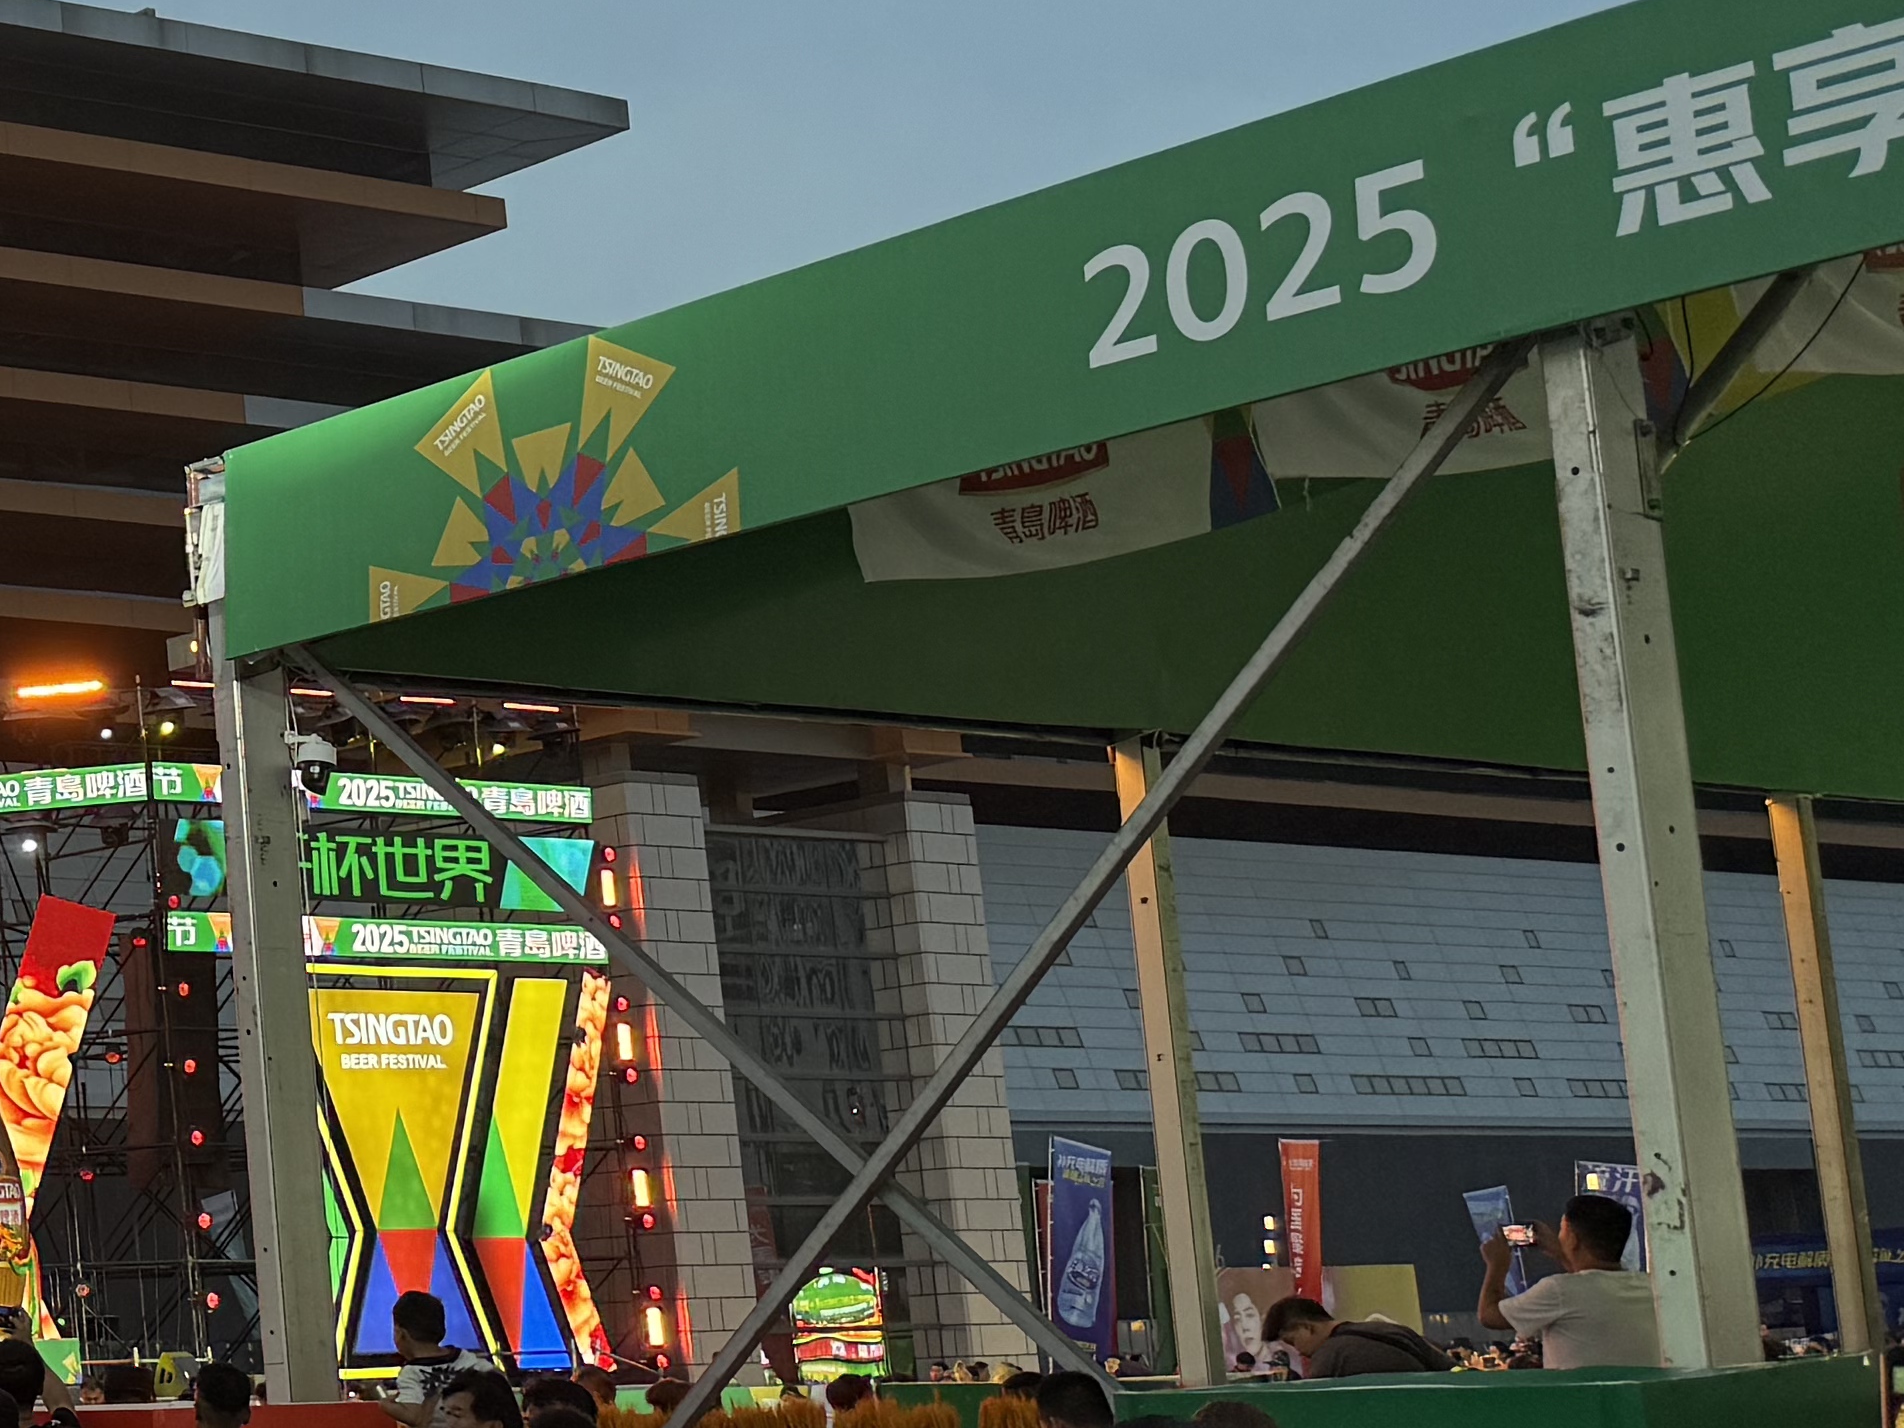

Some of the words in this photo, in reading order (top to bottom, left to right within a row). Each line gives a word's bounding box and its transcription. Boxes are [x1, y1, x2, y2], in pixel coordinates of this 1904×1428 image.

[1083, 159, 1438, 369] 2025
[597, 355, 654, 390] TSINGTAO
[433, 394, 486, 452] TSINGTAO
[989, 492, 1100, 546] 青島啤酒
[23, 769, 146, 806] 青島啤酒
[152, 765, 184, 797] 节
[337, 777, 396, 808] 2025
[480, 785, 591, 818] 青島啤酒
[296, 832, 493, 903] 杯世界
[167, 916, 197, 948] 节
[351, 923, 410, 954] 2025
[408, 926, 493, 946] TSINGTAO
[327, 1012, 454, 1046] TSINGTAO
[340, 1053, 379, 1069] BEER
[380, 1054, 449, 1070] FESTIVAL
